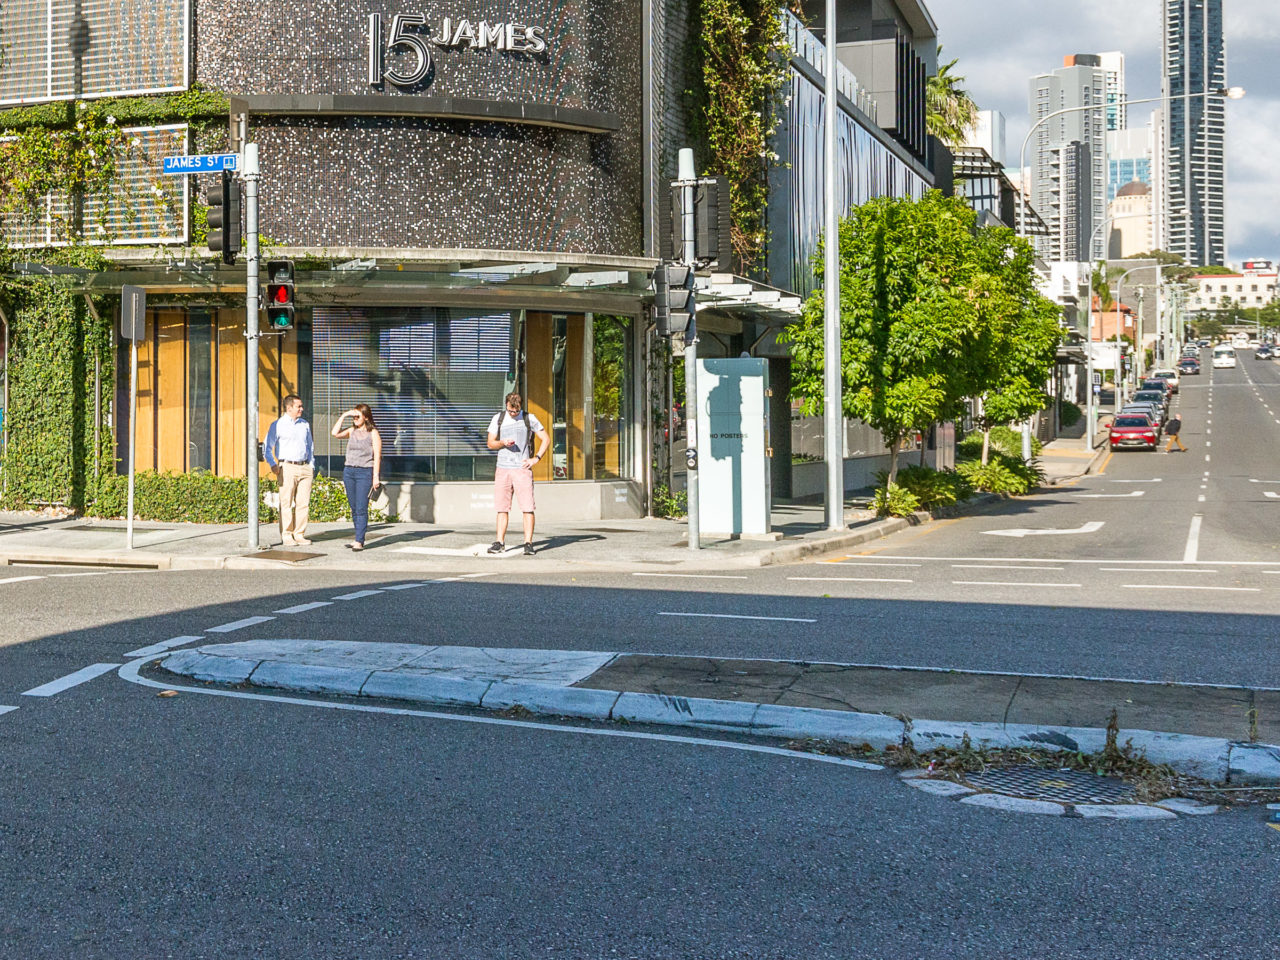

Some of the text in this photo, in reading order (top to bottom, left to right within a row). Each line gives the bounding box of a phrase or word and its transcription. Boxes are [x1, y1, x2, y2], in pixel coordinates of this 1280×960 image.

[370, 13, 546, 86] 15 JAMES
[166, 156, 219, 169] JAMES ST
